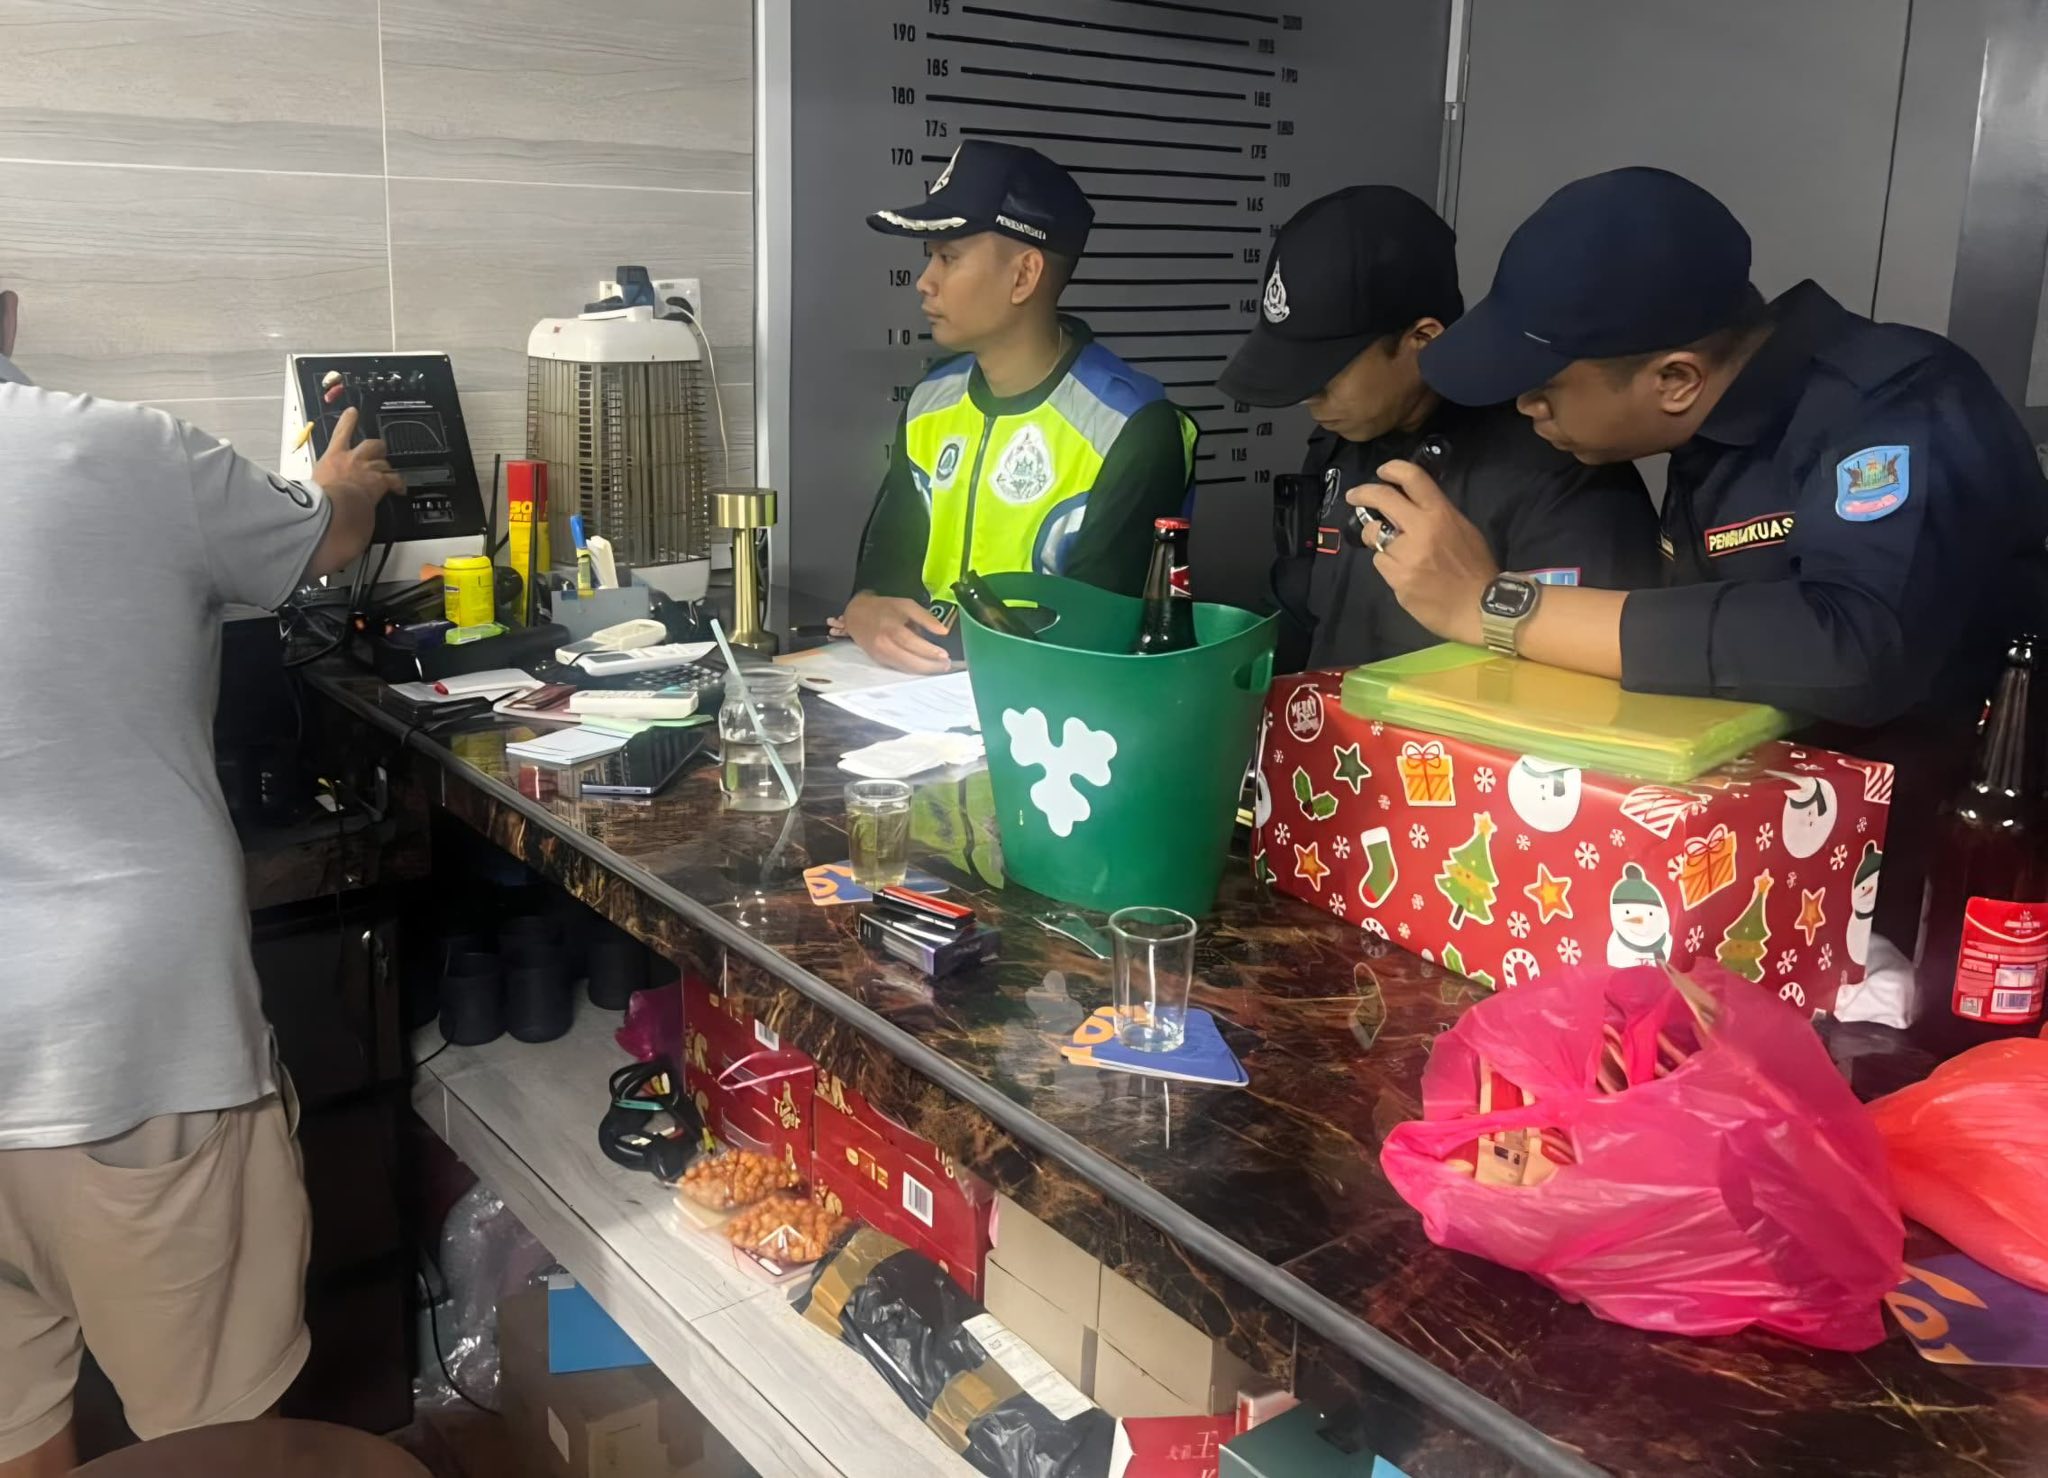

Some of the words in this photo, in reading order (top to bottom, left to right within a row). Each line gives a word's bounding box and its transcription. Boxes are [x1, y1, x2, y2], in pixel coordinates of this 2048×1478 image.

[928, 0, 950, 15] 195
[893, 23, 916, 42] 190
[926, 58, 949, 77] 185
[891, 86, 915, 105] 180
[925, 119, 948, 137] 175
[891, 148, 914, 166] 170
[889, 269, 911, 287] 150
[888, 328, 911, 346] 10
